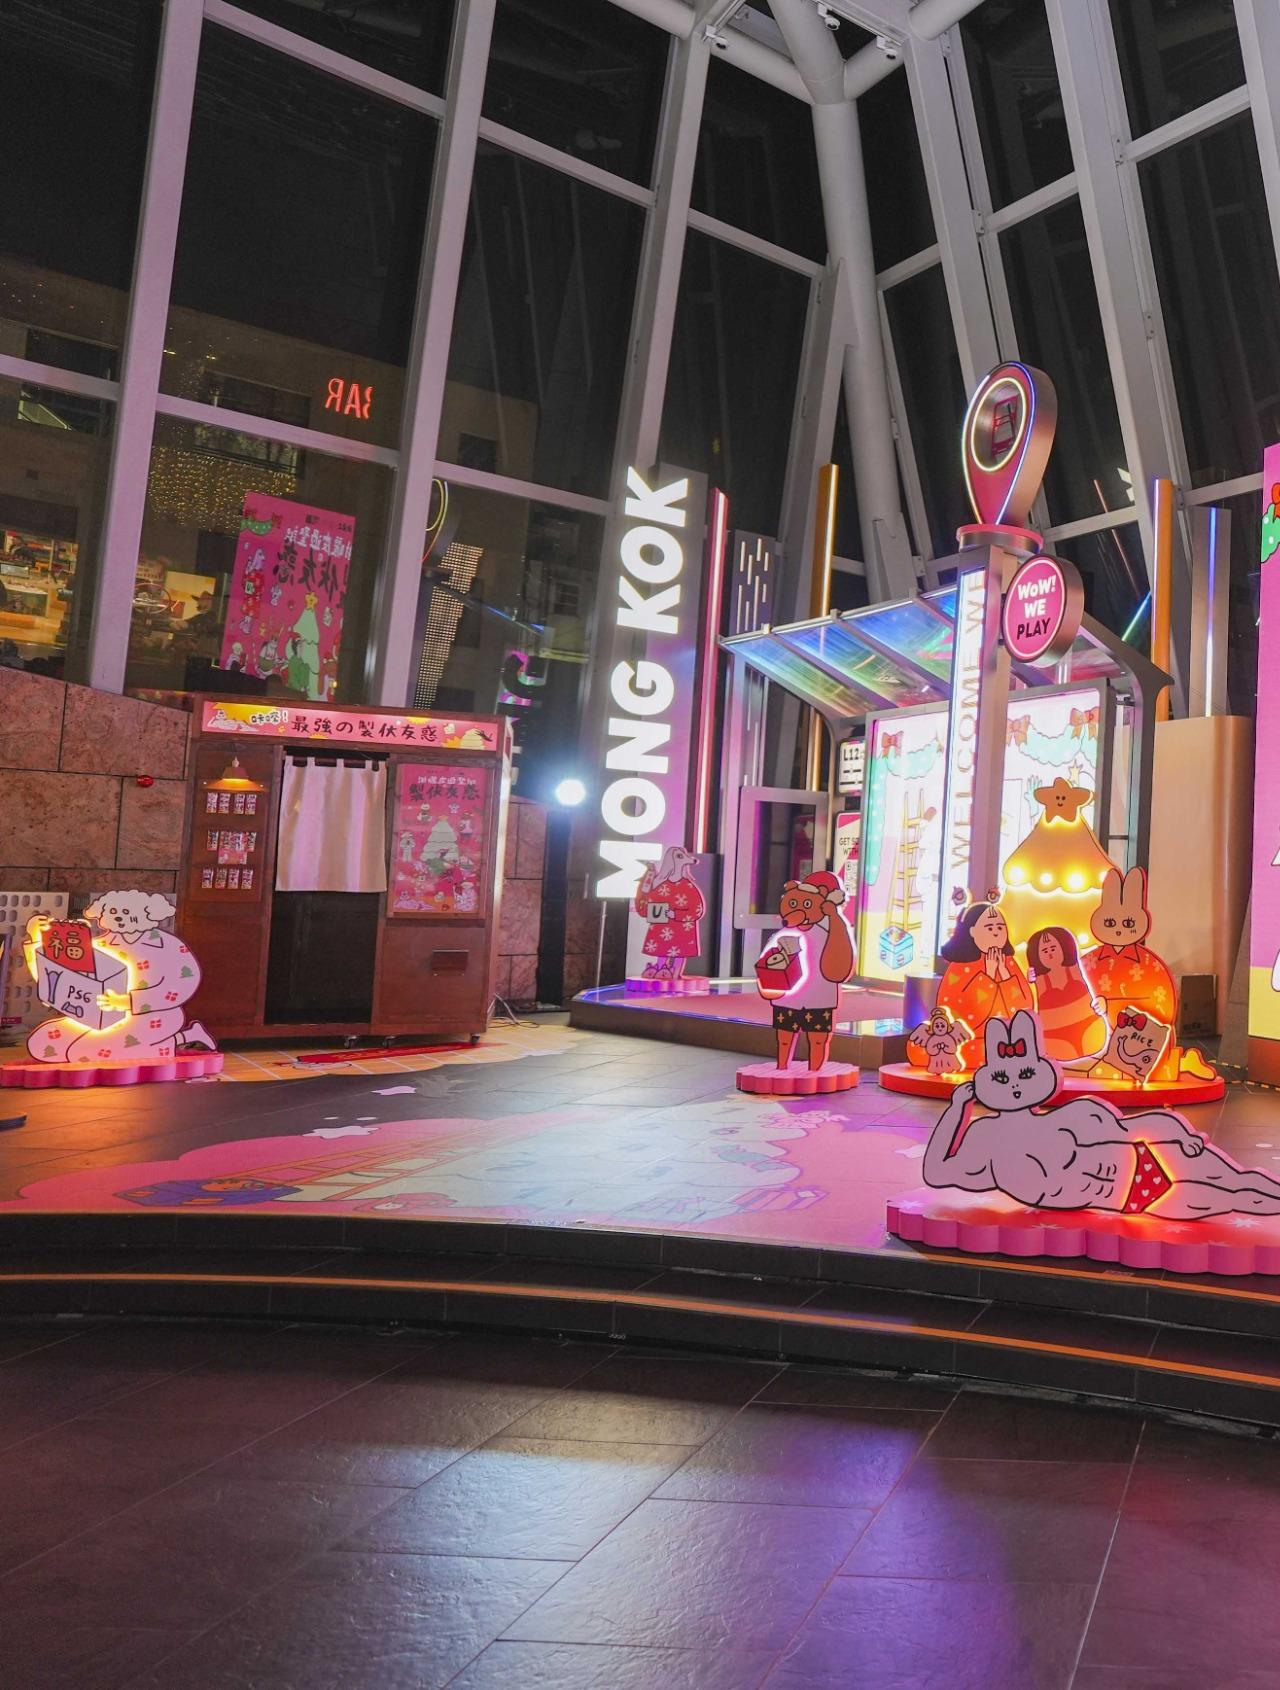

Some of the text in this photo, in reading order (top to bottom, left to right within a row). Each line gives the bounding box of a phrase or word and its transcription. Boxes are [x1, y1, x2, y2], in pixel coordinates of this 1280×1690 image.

[1024, 598, 1047, 619] WE
[1017, 617, 1051, 640] PLAY
[596, 465, 689, 899] MONG KOK
[291, 714, 439, 743] 最強の製伏友惑
[950, 650, 983, 869] WELCOME
[652, 905, 663, 919] U
[49, 930, 84, 961] 福
[1131, 1031, 1154, 1047] RICE
